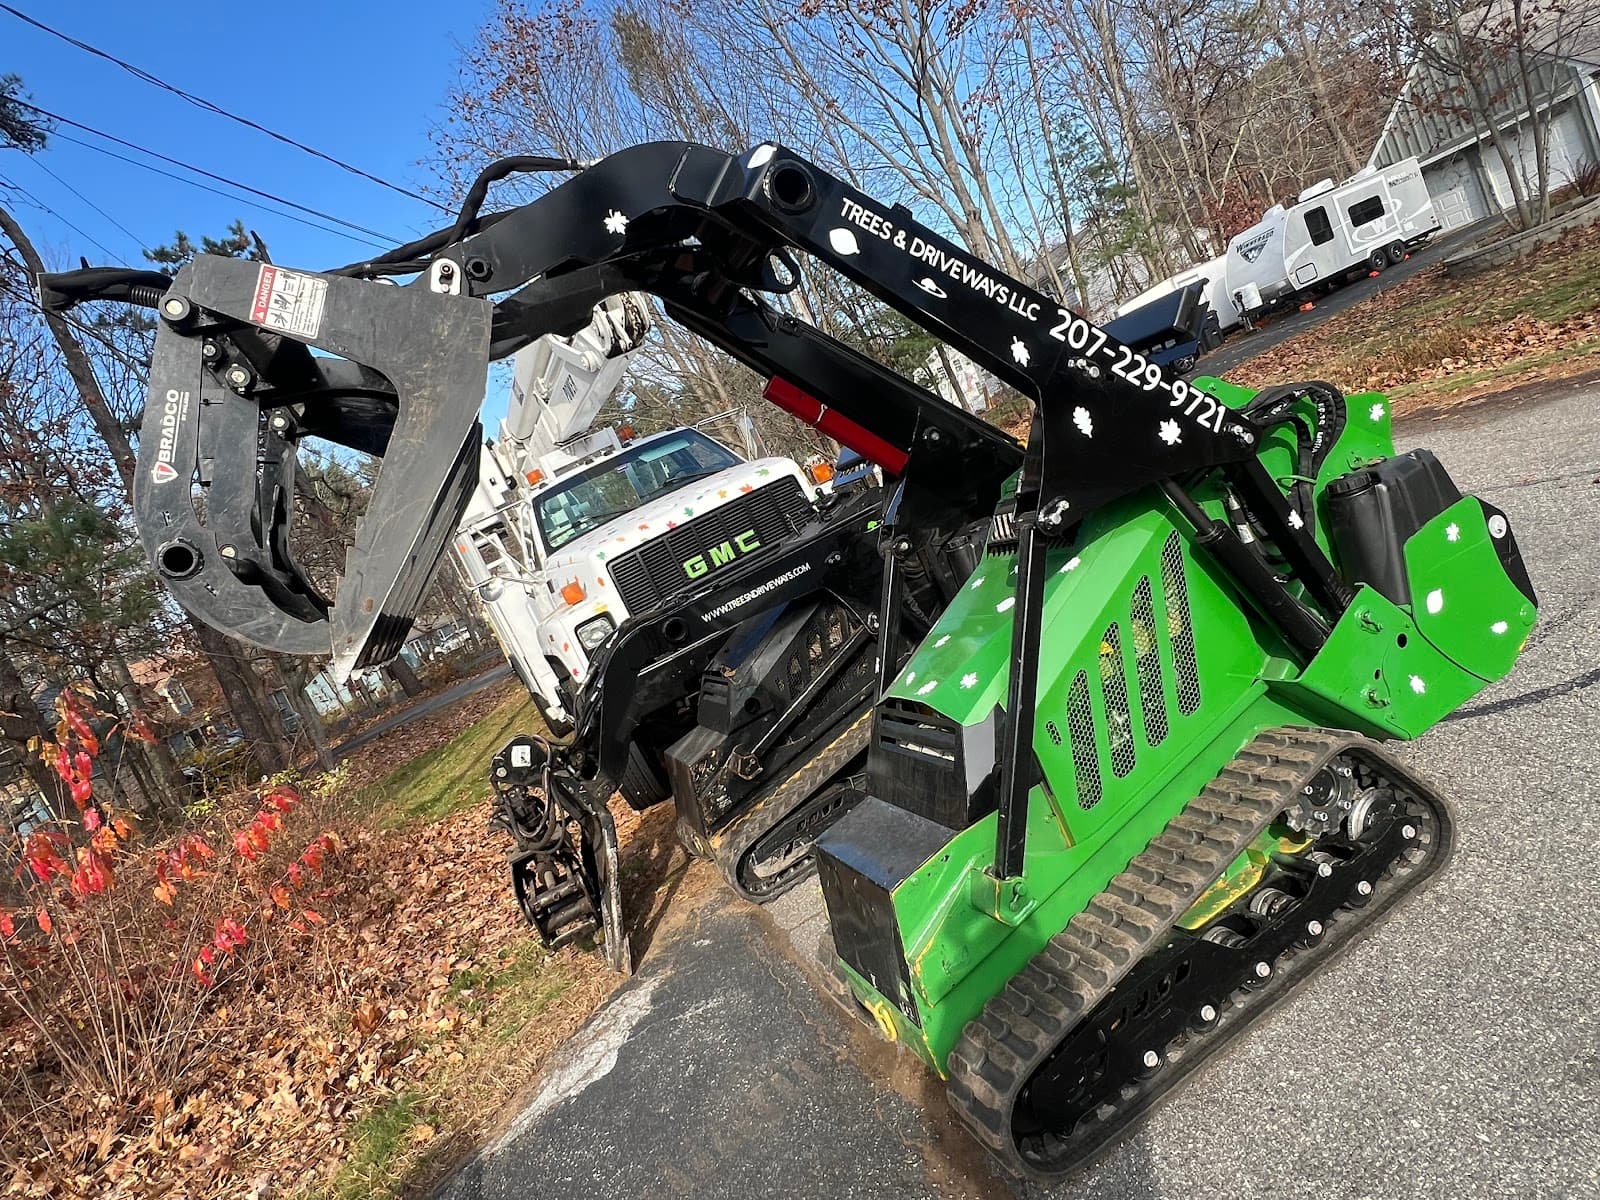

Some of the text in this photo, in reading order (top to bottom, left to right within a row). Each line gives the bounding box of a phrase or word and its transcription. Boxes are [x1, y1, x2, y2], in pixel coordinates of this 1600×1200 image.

[258, 271, 273, 308] DANGER
[842, 197, 1041, 321] TREES & DRIVEWAYS LLC
[1049, 308, 1227, 434] 207-229-9721
[158, 389, 179, 463] BRADCO
[683, 529, 760, 579] GMC
[701, 562, 812, 623] WWW.TREESNDRIVEWAYS.COM
